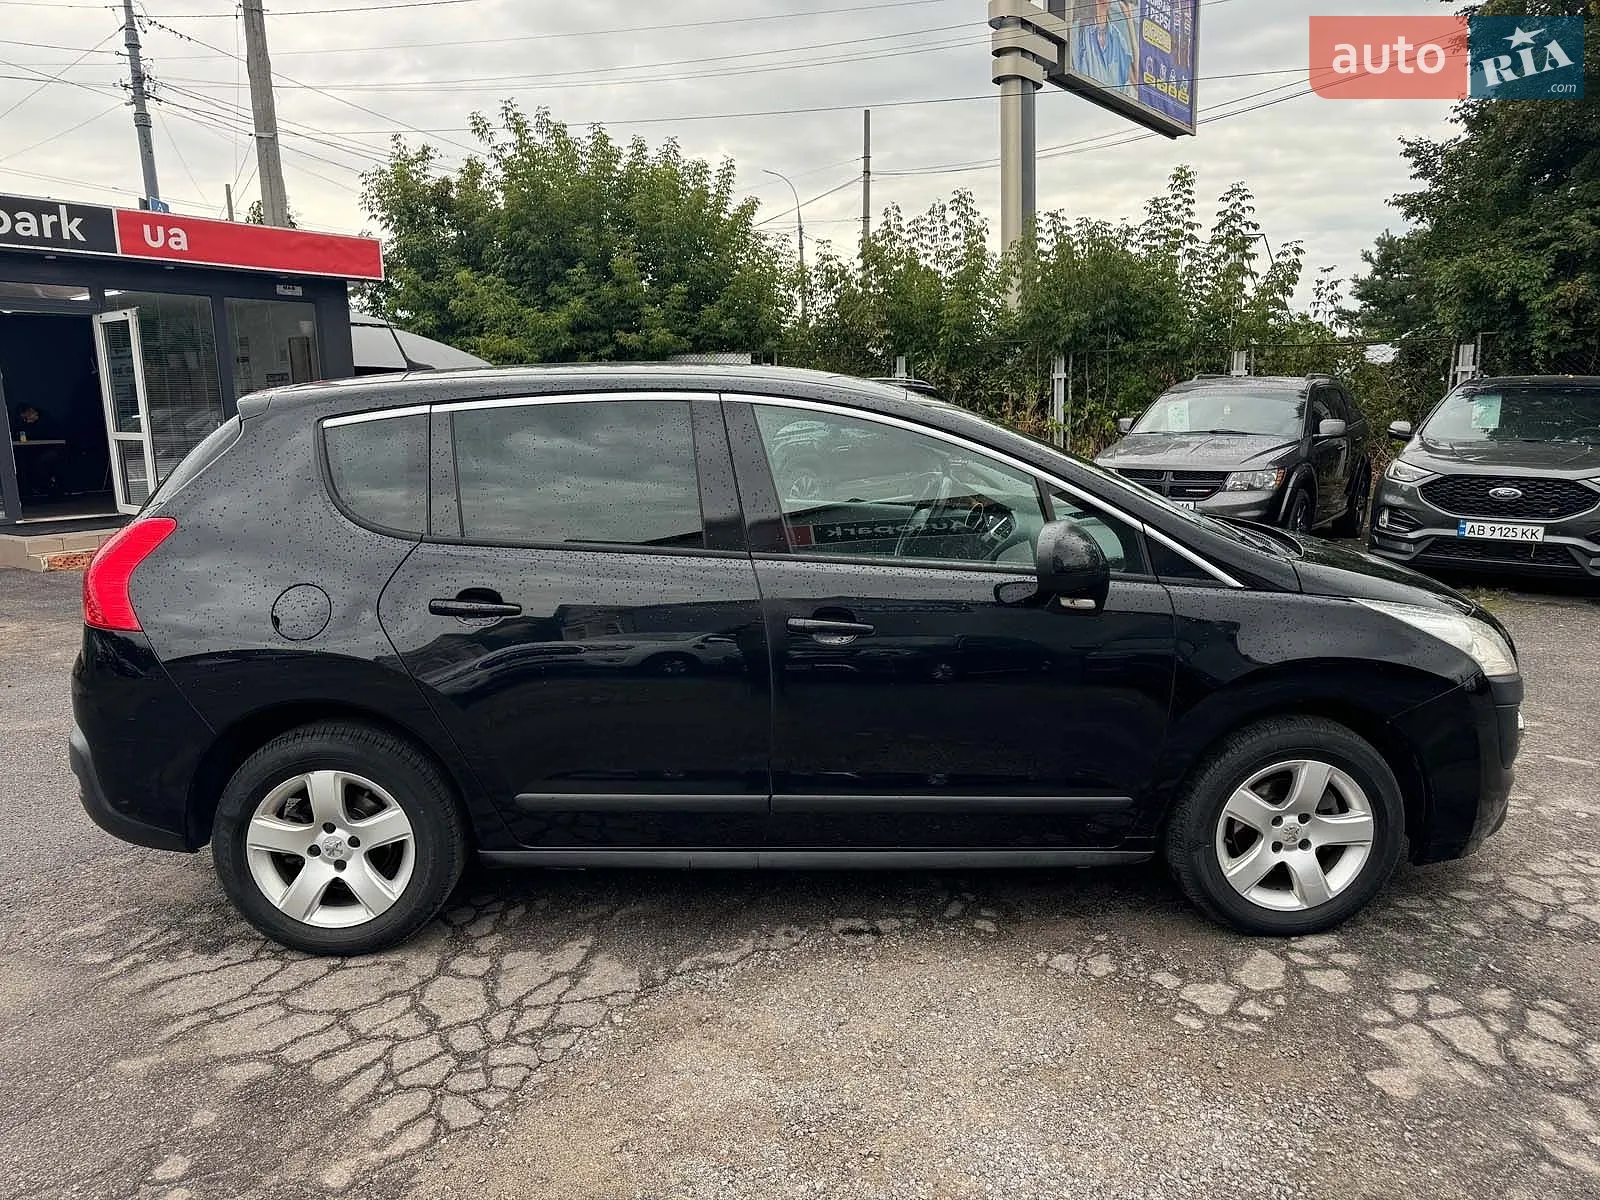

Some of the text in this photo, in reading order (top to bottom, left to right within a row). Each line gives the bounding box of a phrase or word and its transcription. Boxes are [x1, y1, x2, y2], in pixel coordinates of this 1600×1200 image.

[143, 223, 188, 251] ua
[1467, 525, 1540, 540] AB 9125 KK
